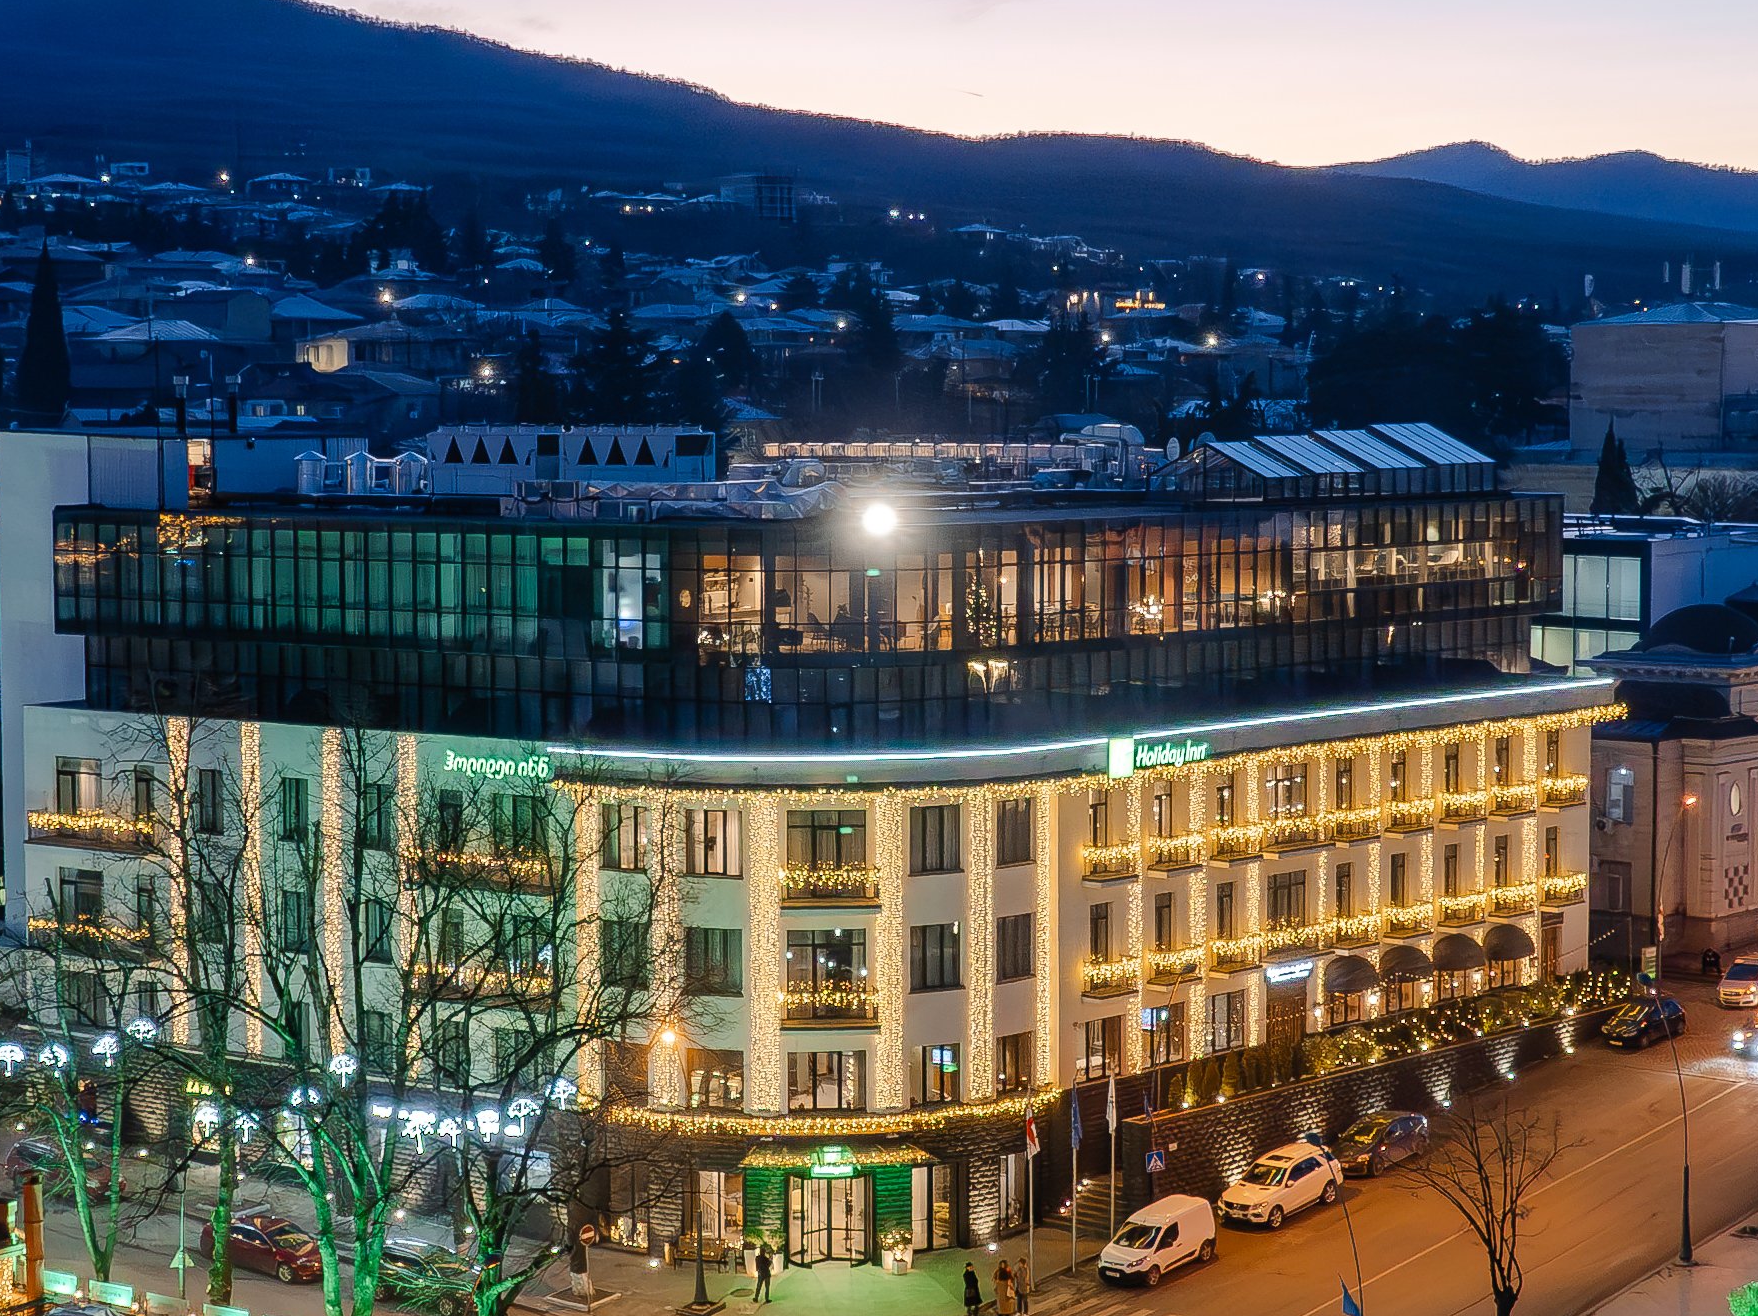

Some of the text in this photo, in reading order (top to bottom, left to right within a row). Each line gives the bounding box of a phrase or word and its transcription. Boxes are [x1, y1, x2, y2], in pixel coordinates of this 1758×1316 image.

[444, 749, 515, 780] ჰოლიდეი
[1136, 740, 1207, 767] Holiday Inn
